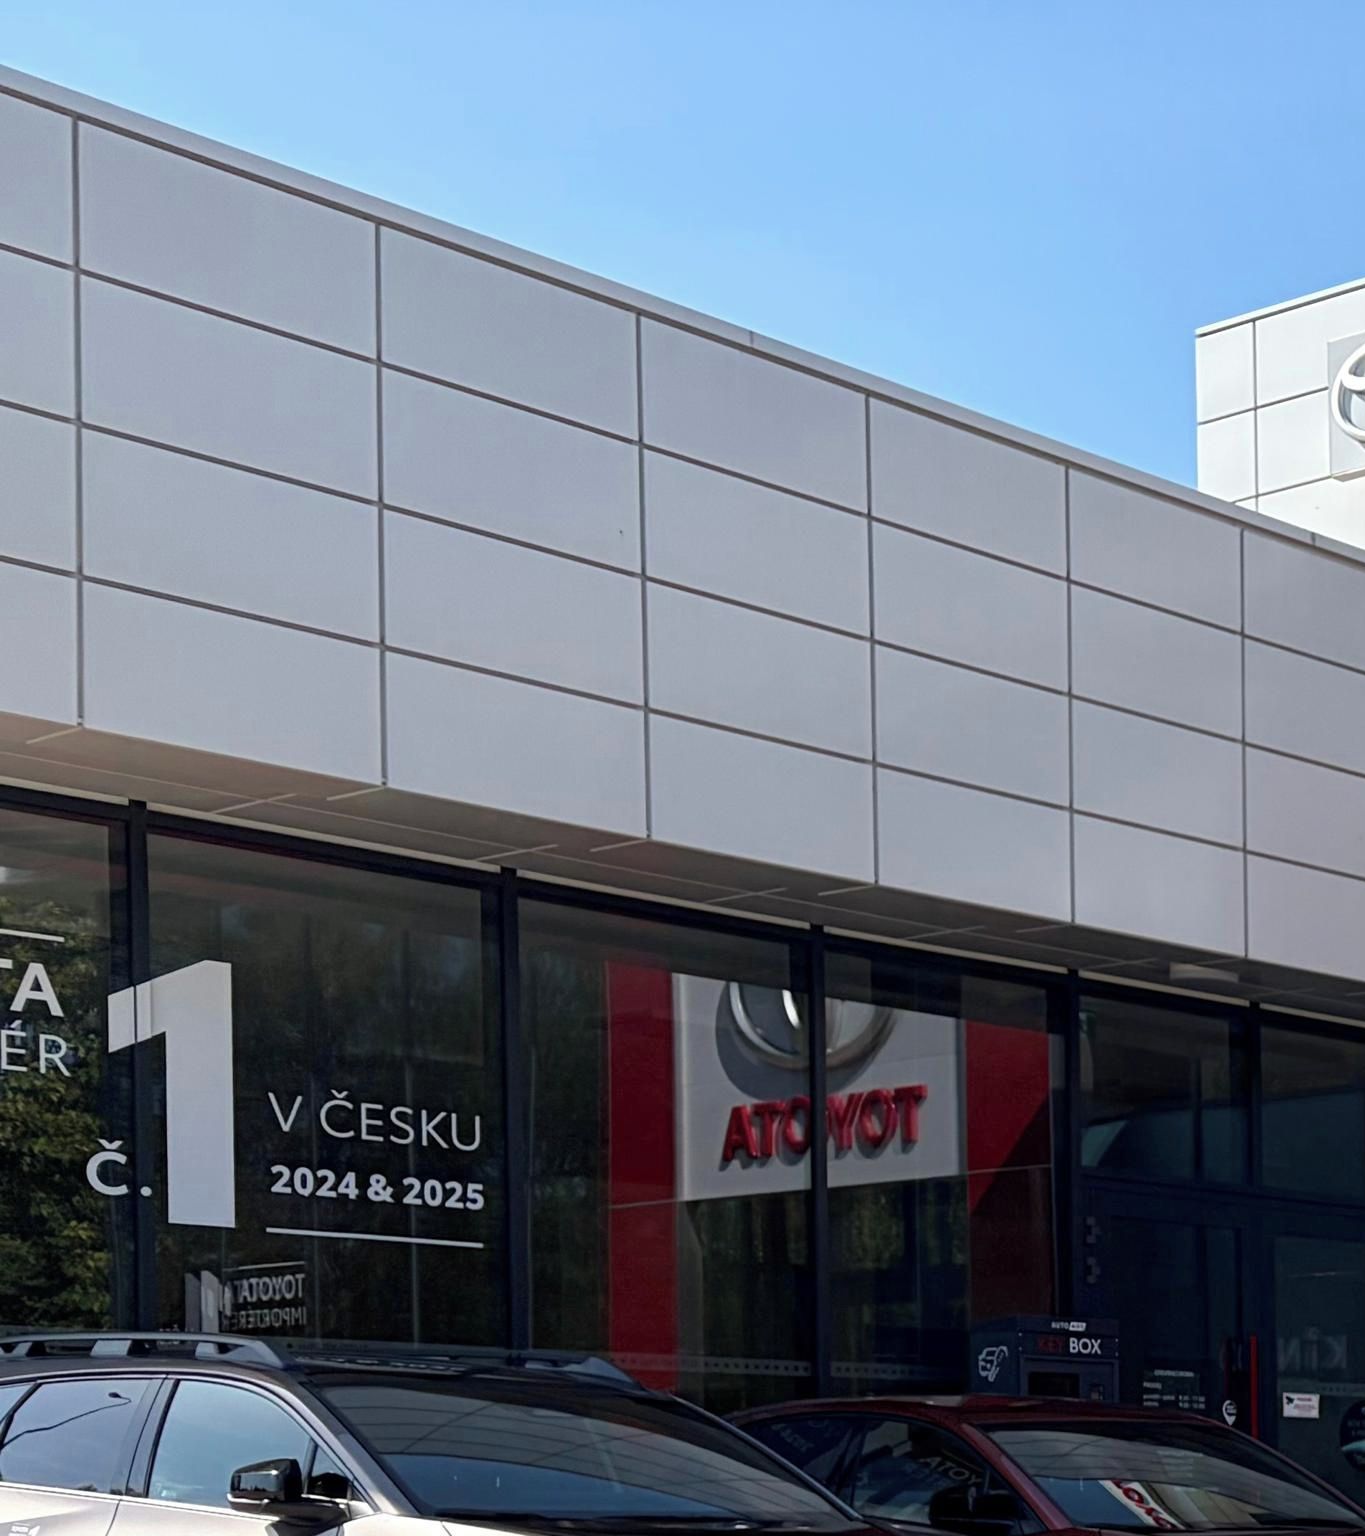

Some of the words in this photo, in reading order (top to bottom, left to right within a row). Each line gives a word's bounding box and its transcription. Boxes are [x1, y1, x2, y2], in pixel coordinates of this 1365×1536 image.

[107, 959, 236, 1228] 1
[268, 1091, 302, 1132] V
[319, 1088, 482, 1152] ČESKU
[270, 1164, 359, 1201] 2024
[366, 1174, 394, 1204] &
[402, 1176, 485, 1212] 2025
[1069, 1337, 1102, 1355] BOX
